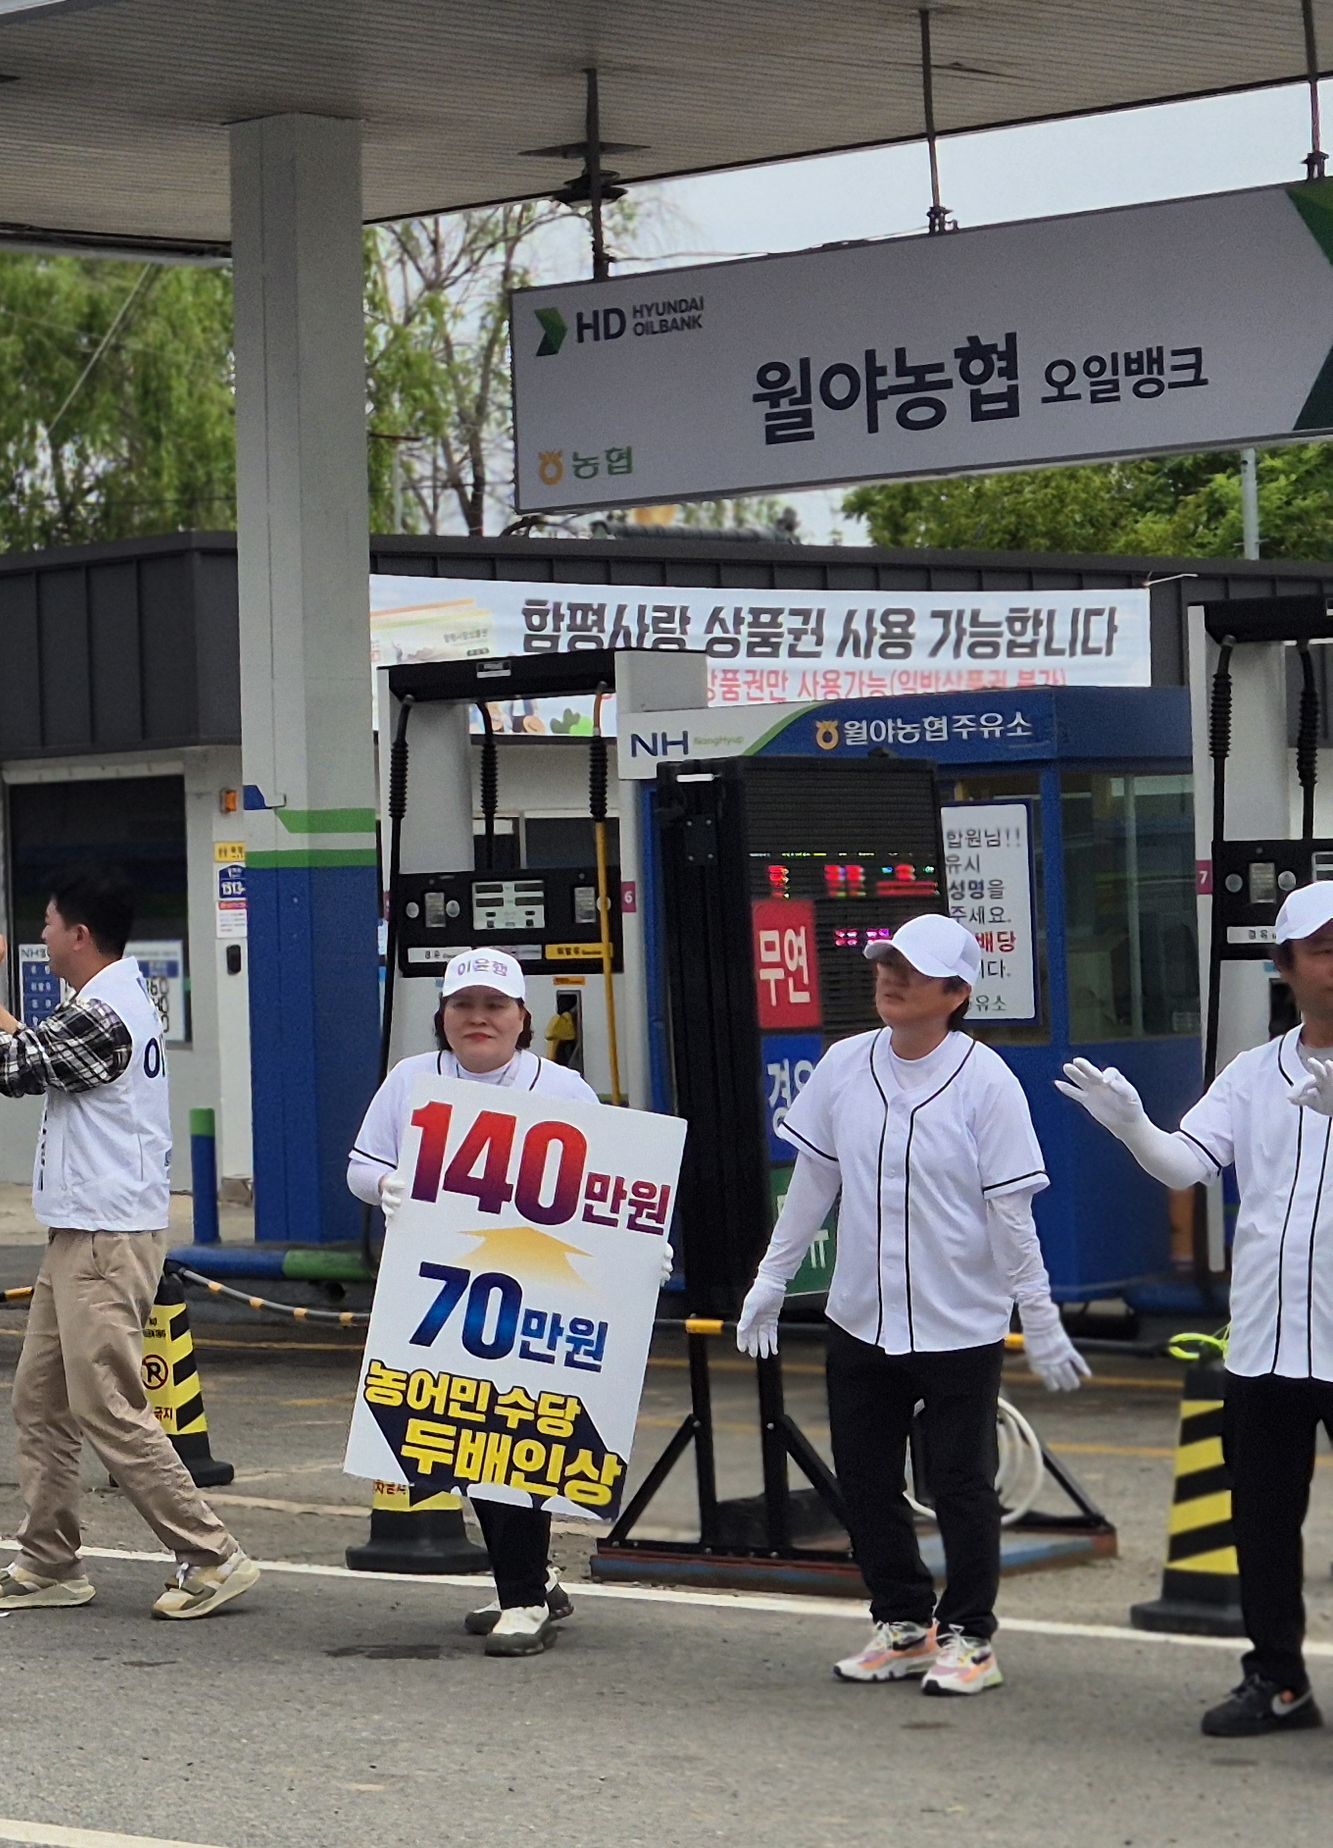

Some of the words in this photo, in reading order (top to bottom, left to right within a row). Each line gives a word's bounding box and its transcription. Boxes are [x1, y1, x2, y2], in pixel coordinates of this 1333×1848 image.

[576, 306, 628, 343] HD
[632, 296, 704, 320] HYUNDAI
[632, 315, 704, 338] OILBANK
[752, 332, 1021, 446] 월야농협
[1041, 345, 1209, 405] 오일뱅크
[572, 445, 634, 480] 농협
[522, 599, 690, 652] 함평사랑
[704, 606, 825, 658] 상품권
[836, 606, 916, 659] 사용
[931, 605, 1118, 659] 가능합니다
[631, 731, 689, 758] NH
[949, 879, 1005, 900] 성명을
[1199, 871, 1208, 885] 7
[457, 958, 508, 976] 이윤행
[759, 927, 810, 1006] 무연
[410, 1100, 671, 1236] 140만원
[409, 1261, 609, 1373] 70만원
[364, 1359, 492, 1423] 농어민
[494, 1386, 582, 1438] 수당
[400, 1418, 623, 1506] 두배인상
